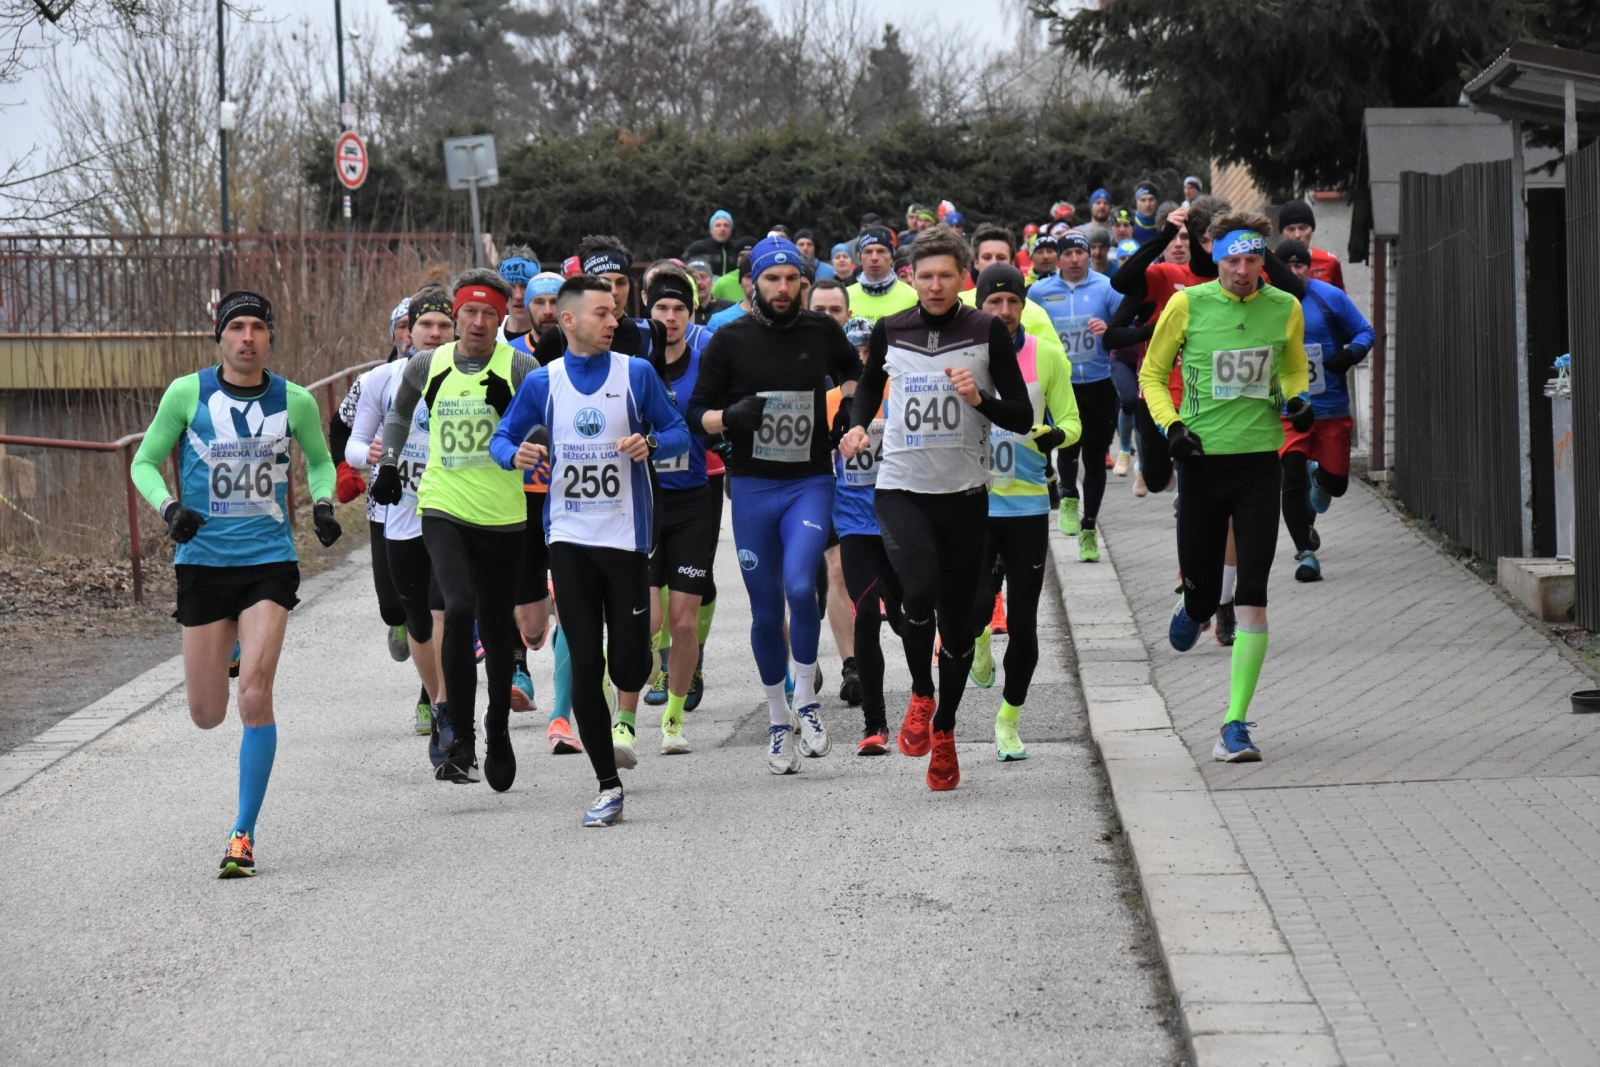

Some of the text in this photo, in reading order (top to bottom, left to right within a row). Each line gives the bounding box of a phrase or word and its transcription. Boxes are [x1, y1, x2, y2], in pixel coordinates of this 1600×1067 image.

[1060, 331, 1095, 354] 676
[1216, 350, 1270, 384] 657
[905, 375, 928, 384] ZIMNÍ
[437, 399, 460, 408] ZIMNÍ
[796, 402, 812, 411] LIGA
[437, 408, 470, 416] BĚŽECKÁ
[904, 396, 961, 431] 640
[757, 413, 812, 447] 669
[996, 429, 1014, 437] LIGA
[440, 419, 494, 453] 632
[211, 441, 238, 451] ZIMNÍ
[562, 443, 585, 451] ZIMNÍ
[211, 450, 250, 458] BĚŽECKÁ
[562, 451, 619, 460] BĚŽECKÁ LIGA
[212, 462, 272, 499] 646
[563, 464, 620, 498] 256
